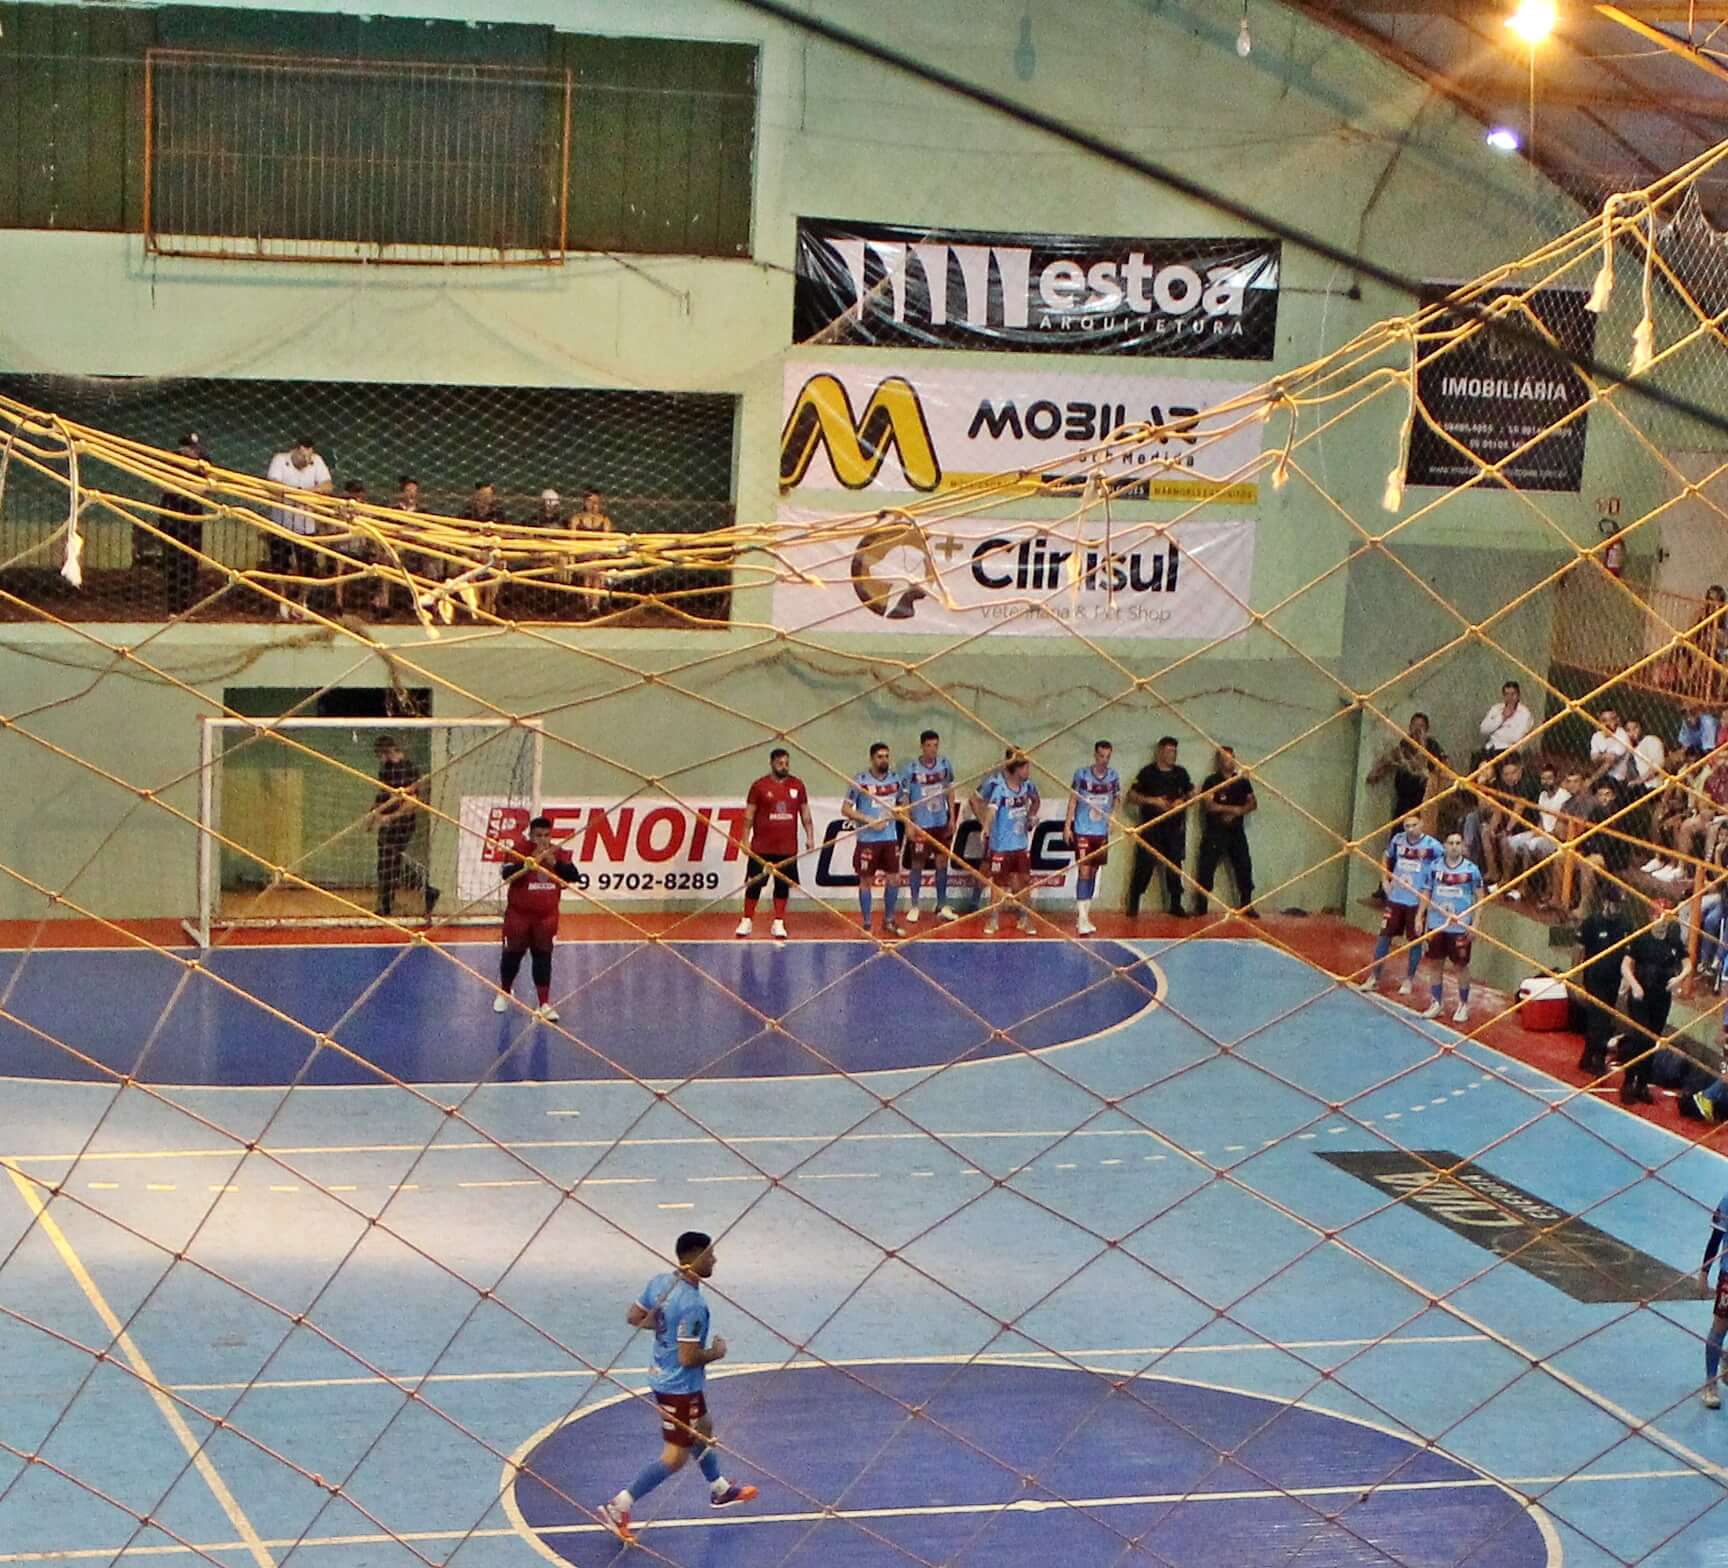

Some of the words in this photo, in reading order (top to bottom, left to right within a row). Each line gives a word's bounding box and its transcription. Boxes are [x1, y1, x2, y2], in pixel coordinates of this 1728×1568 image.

[1040, 252, 1246, 317] estoa
[1040, 315, 1244, 335] ARQUITETURA
[1441, 376, 1569, 401] IMOBILIÁRIA
[1129, 604, 1173, 623] Shop
[481, 807, 749, 863] BENOIT
[598, 873, 719, 890] 9702-8289
